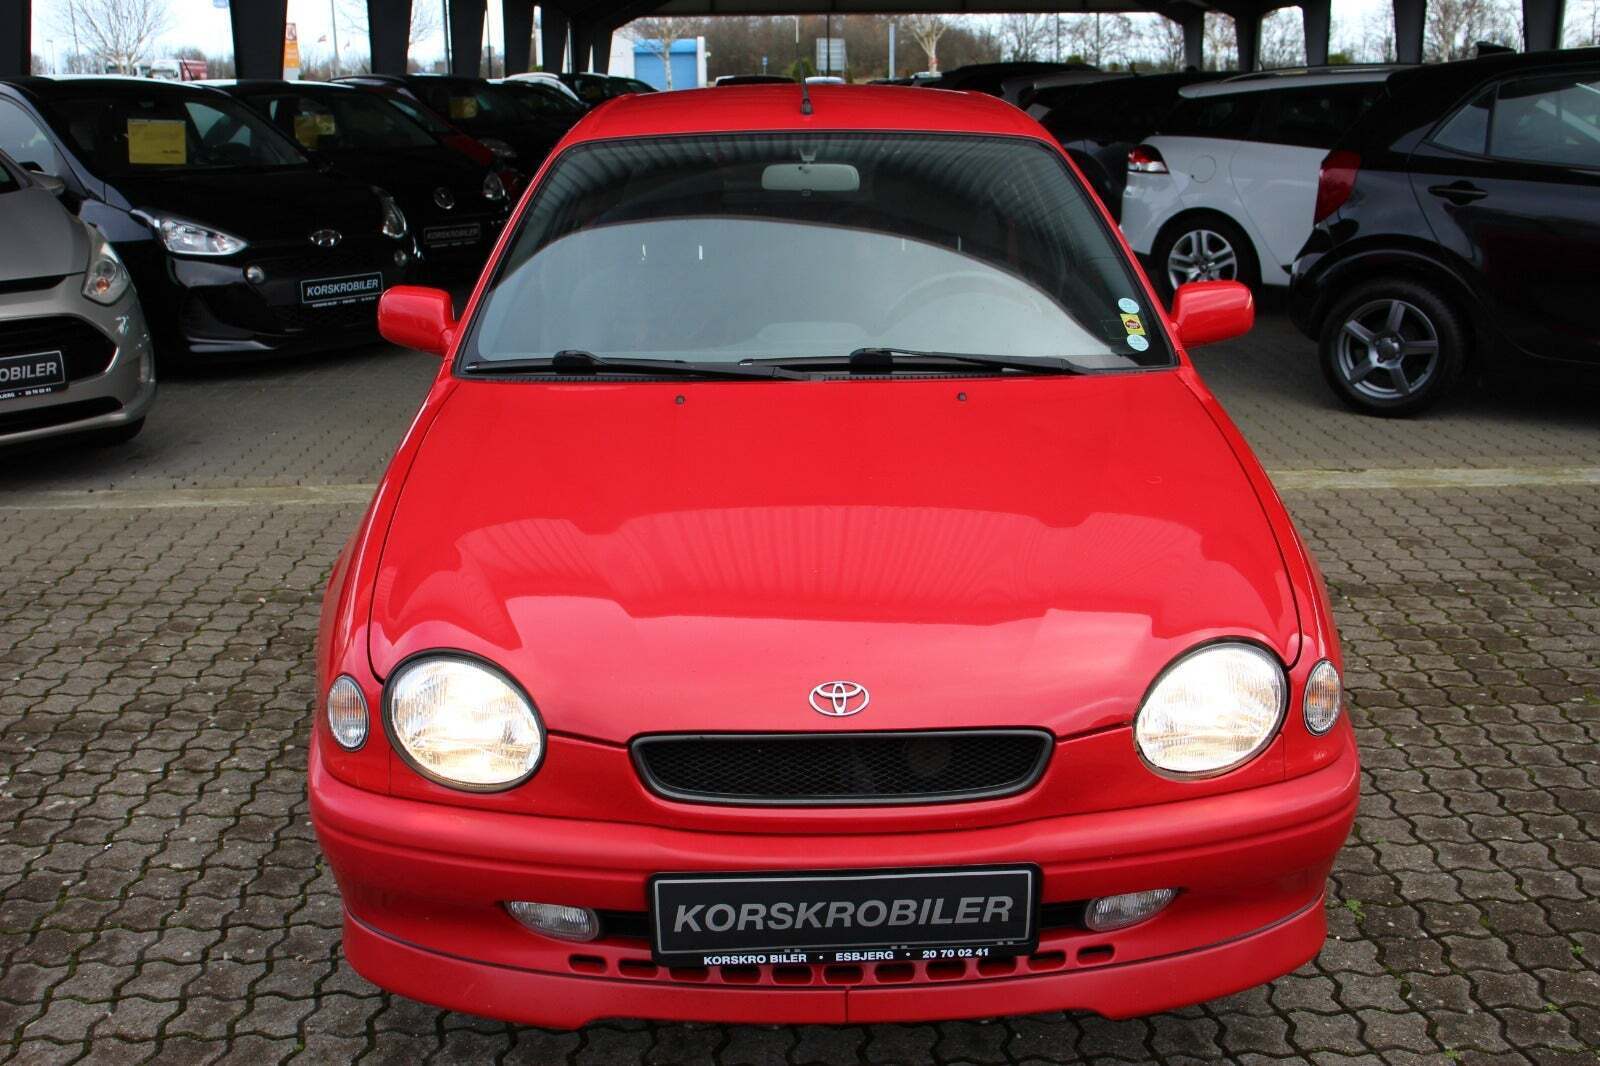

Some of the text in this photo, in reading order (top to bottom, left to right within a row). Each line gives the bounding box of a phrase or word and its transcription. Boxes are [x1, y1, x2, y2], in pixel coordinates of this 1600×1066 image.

[306, 279, 378, 297] KORSKROBILER
[674, 896, 1014, 932] KORSKROBILER
[703, 948, 990, 965] KORSKRO BILER ESBJERG 20 70 02 41
